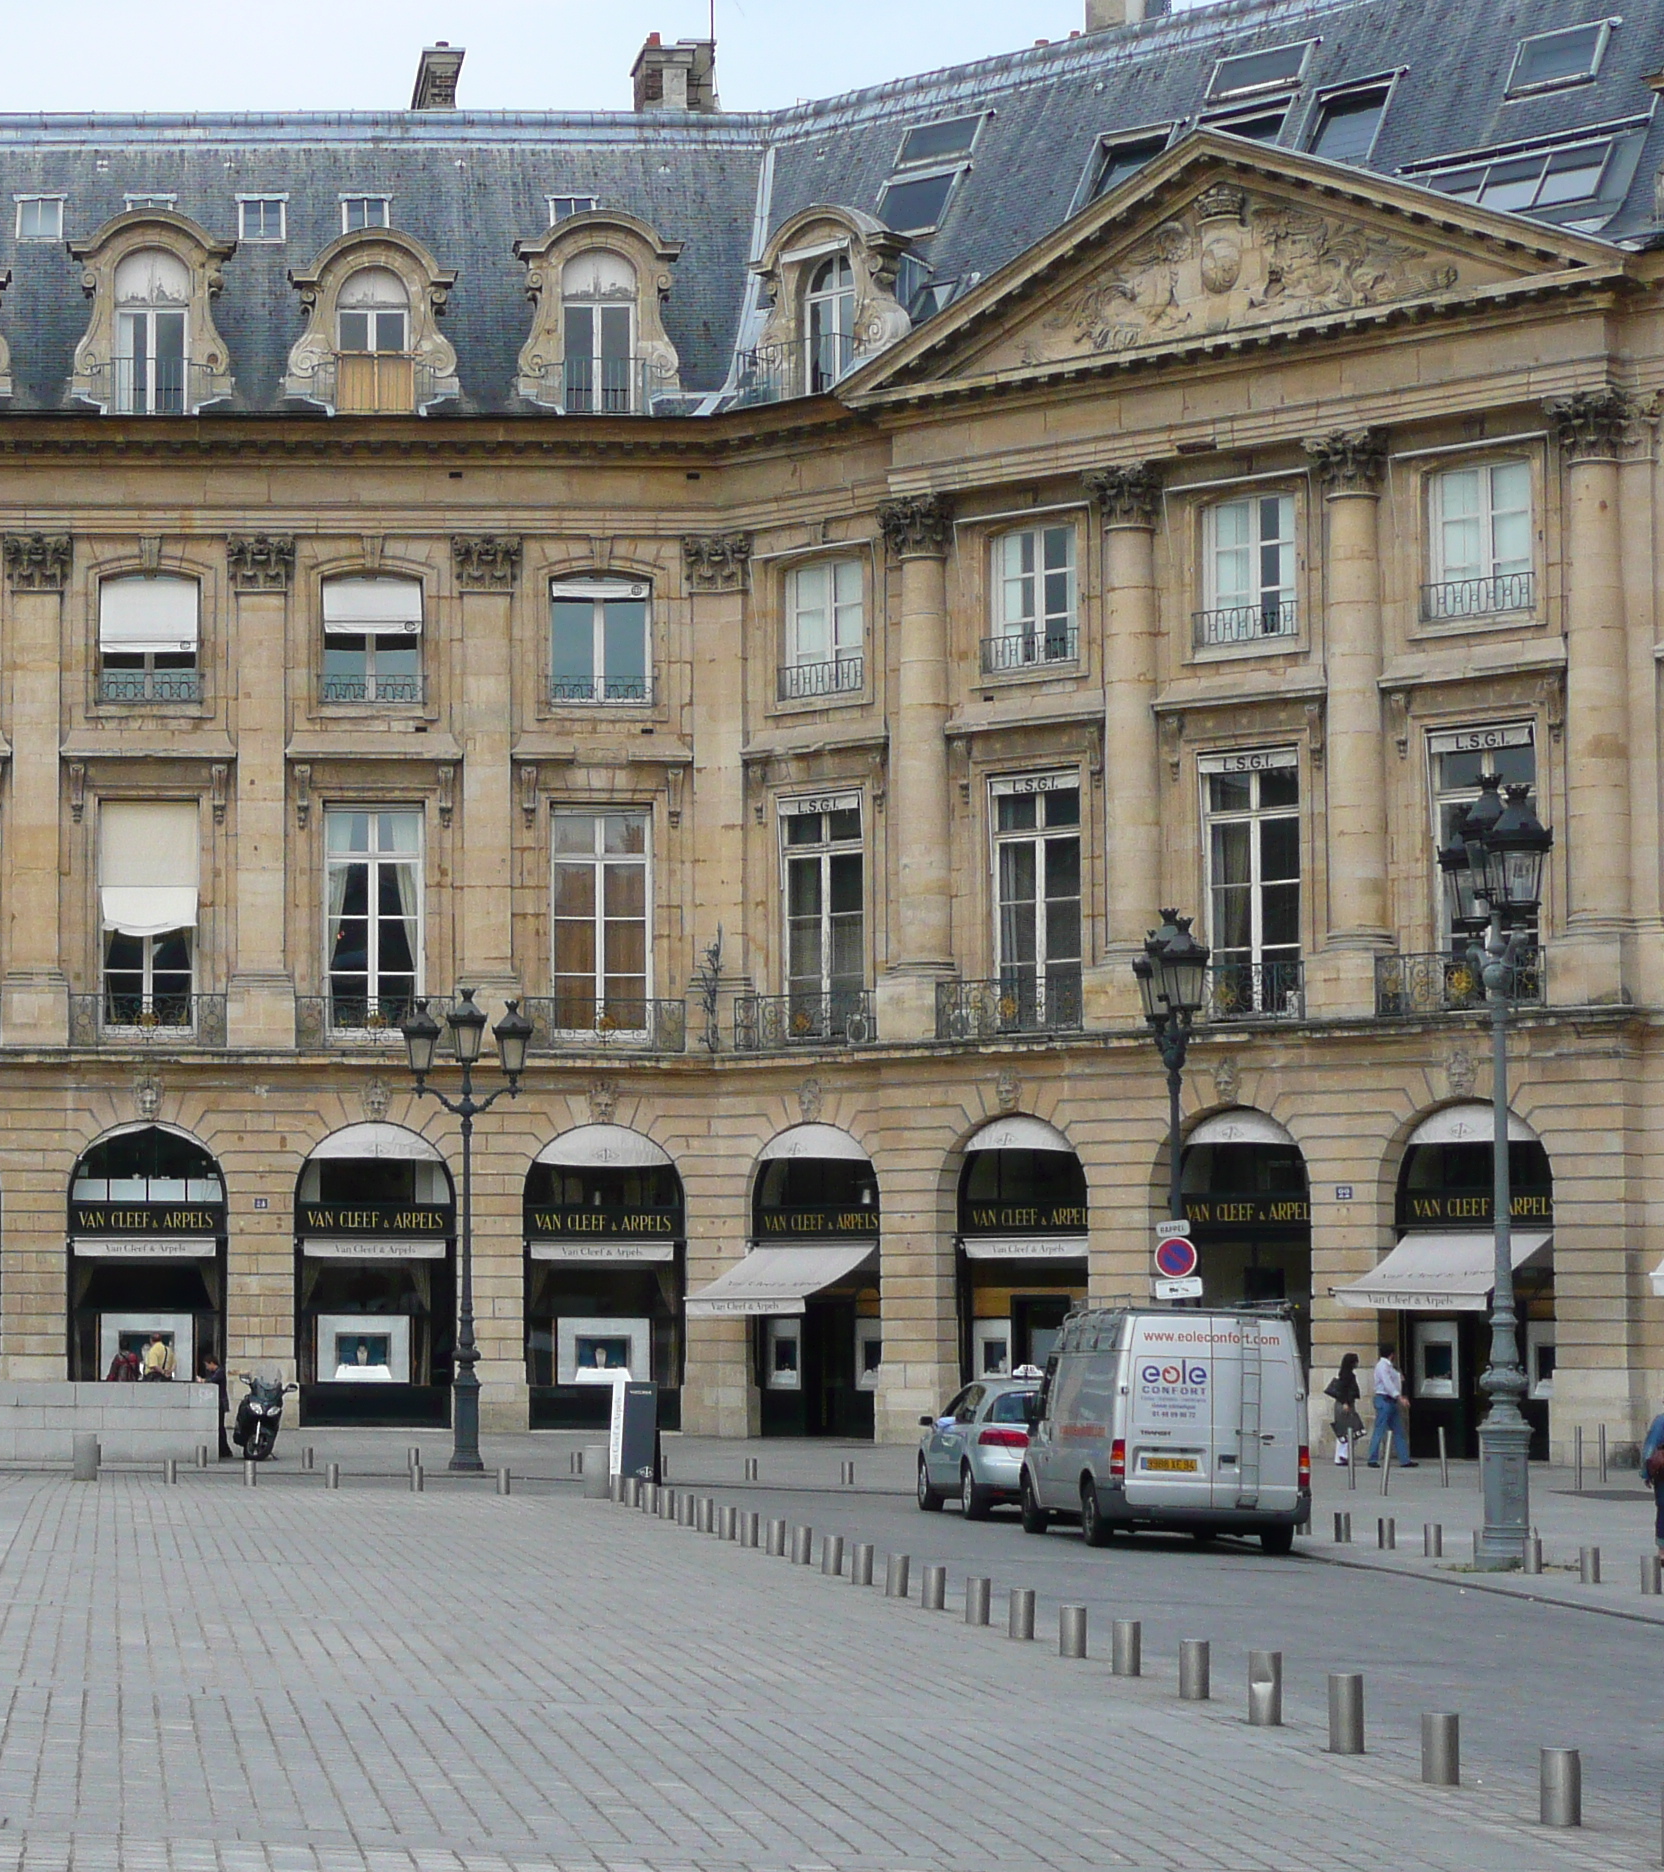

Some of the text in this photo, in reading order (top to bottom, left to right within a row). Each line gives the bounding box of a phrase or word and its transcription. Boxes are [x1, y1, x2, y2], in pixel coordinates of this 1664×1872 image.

[1455, 731, 1510, 750] L.S.G.I.
[1223, 755, 1274, 771] L.S.G.I.
[1012, 775, 1059, 793] L.S.G.I.
[798, 798, 839, 814] L.S.G.I.
[1186, 1204, 1209, 1222] VAN
[1216, 1203, 1255, 1221] CLEEF
[1269, 1202, 1311, 1221] ARPEL
[1413, 1199, 1441, 1217] VAN
[1447, 1198, 1490, 1217] CLEEF
[79, 1211, 213, 1229] VAN CLEEF & ARPELS
[307, 1211, 443, 1229] VAN CLEEF & ARPELS
[535, 1214, 672, 1232] VAN CLEEF & ARPELS
[764, 1214, 786, 1231] VAN
[791, 1214, 824, 1231] CLEEF
[836, 1213, 878, 1230] ARPELS
[973, 1209, 996, 1227] VAN
[1001, 1208, 1038, 1226] CLEEF
[1051, 1208, 1088, 1225] ARPEL
[1160, 1224, 1186, 1235] RAPPEL
[124, 1243, 148, 1253] Cleef
[159, 1244, 186, 1255] Arpels
[354, 1244, 376, 1254] Cleef
[388, 1245, 416, 1256] Arpels
[580, 1247, 605, 1256] Cleef
[616, 1247, 644, 1258] Arpels
[1008, 1244, 1029, 1253] Cleef
[1040, 1244, 1065, 1255] Arpels
[727, 1301, 746, 1310] Cleef
[756, 1300, 779, 1311] Arpels
[1387, 1293, 1413, 1304] Cleef
[1425, 1294, 1454, 1307] Arpels
[1141, 1359, 1207, 1385] eole
[1141, 1386, 1207, 1395] CONFORT
